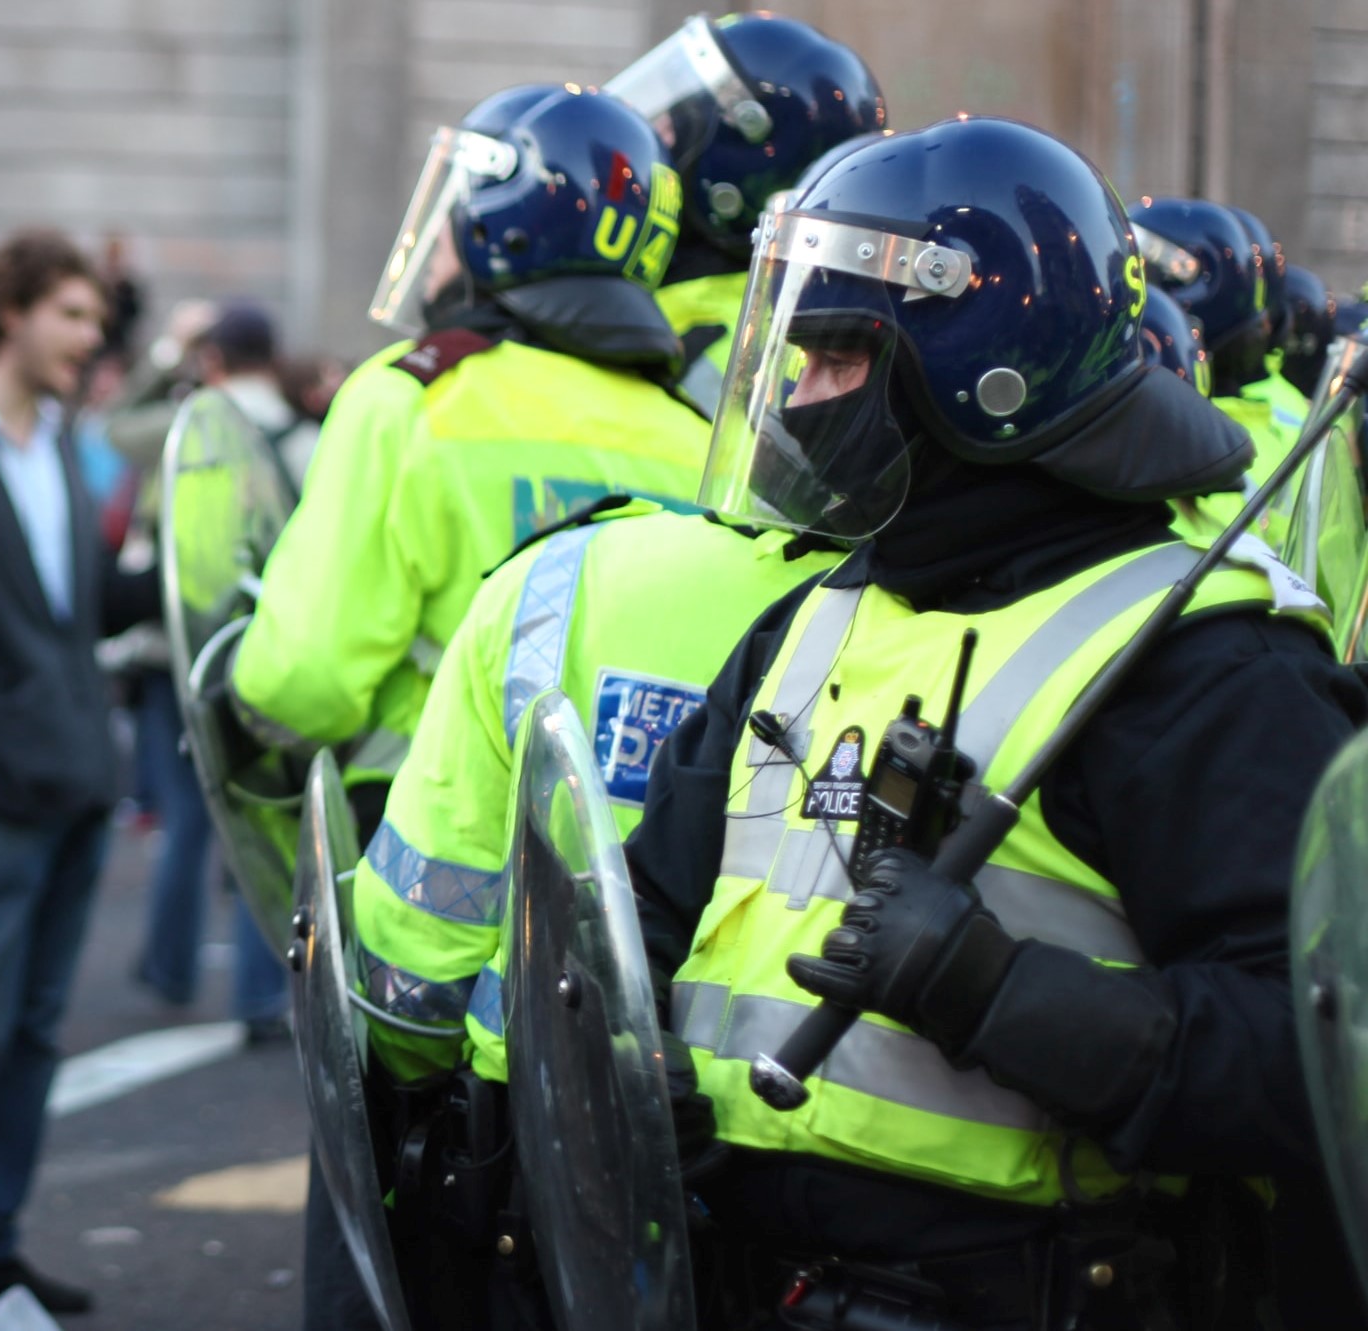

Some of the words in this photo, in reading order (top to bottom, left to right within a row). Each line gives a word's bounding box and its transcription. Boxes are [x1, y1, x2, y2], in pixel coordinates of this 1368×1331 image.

[594, 205, 637, 261] U
[604, 721, 666, 782] P
[807, 790, 861, 814] POLICE
